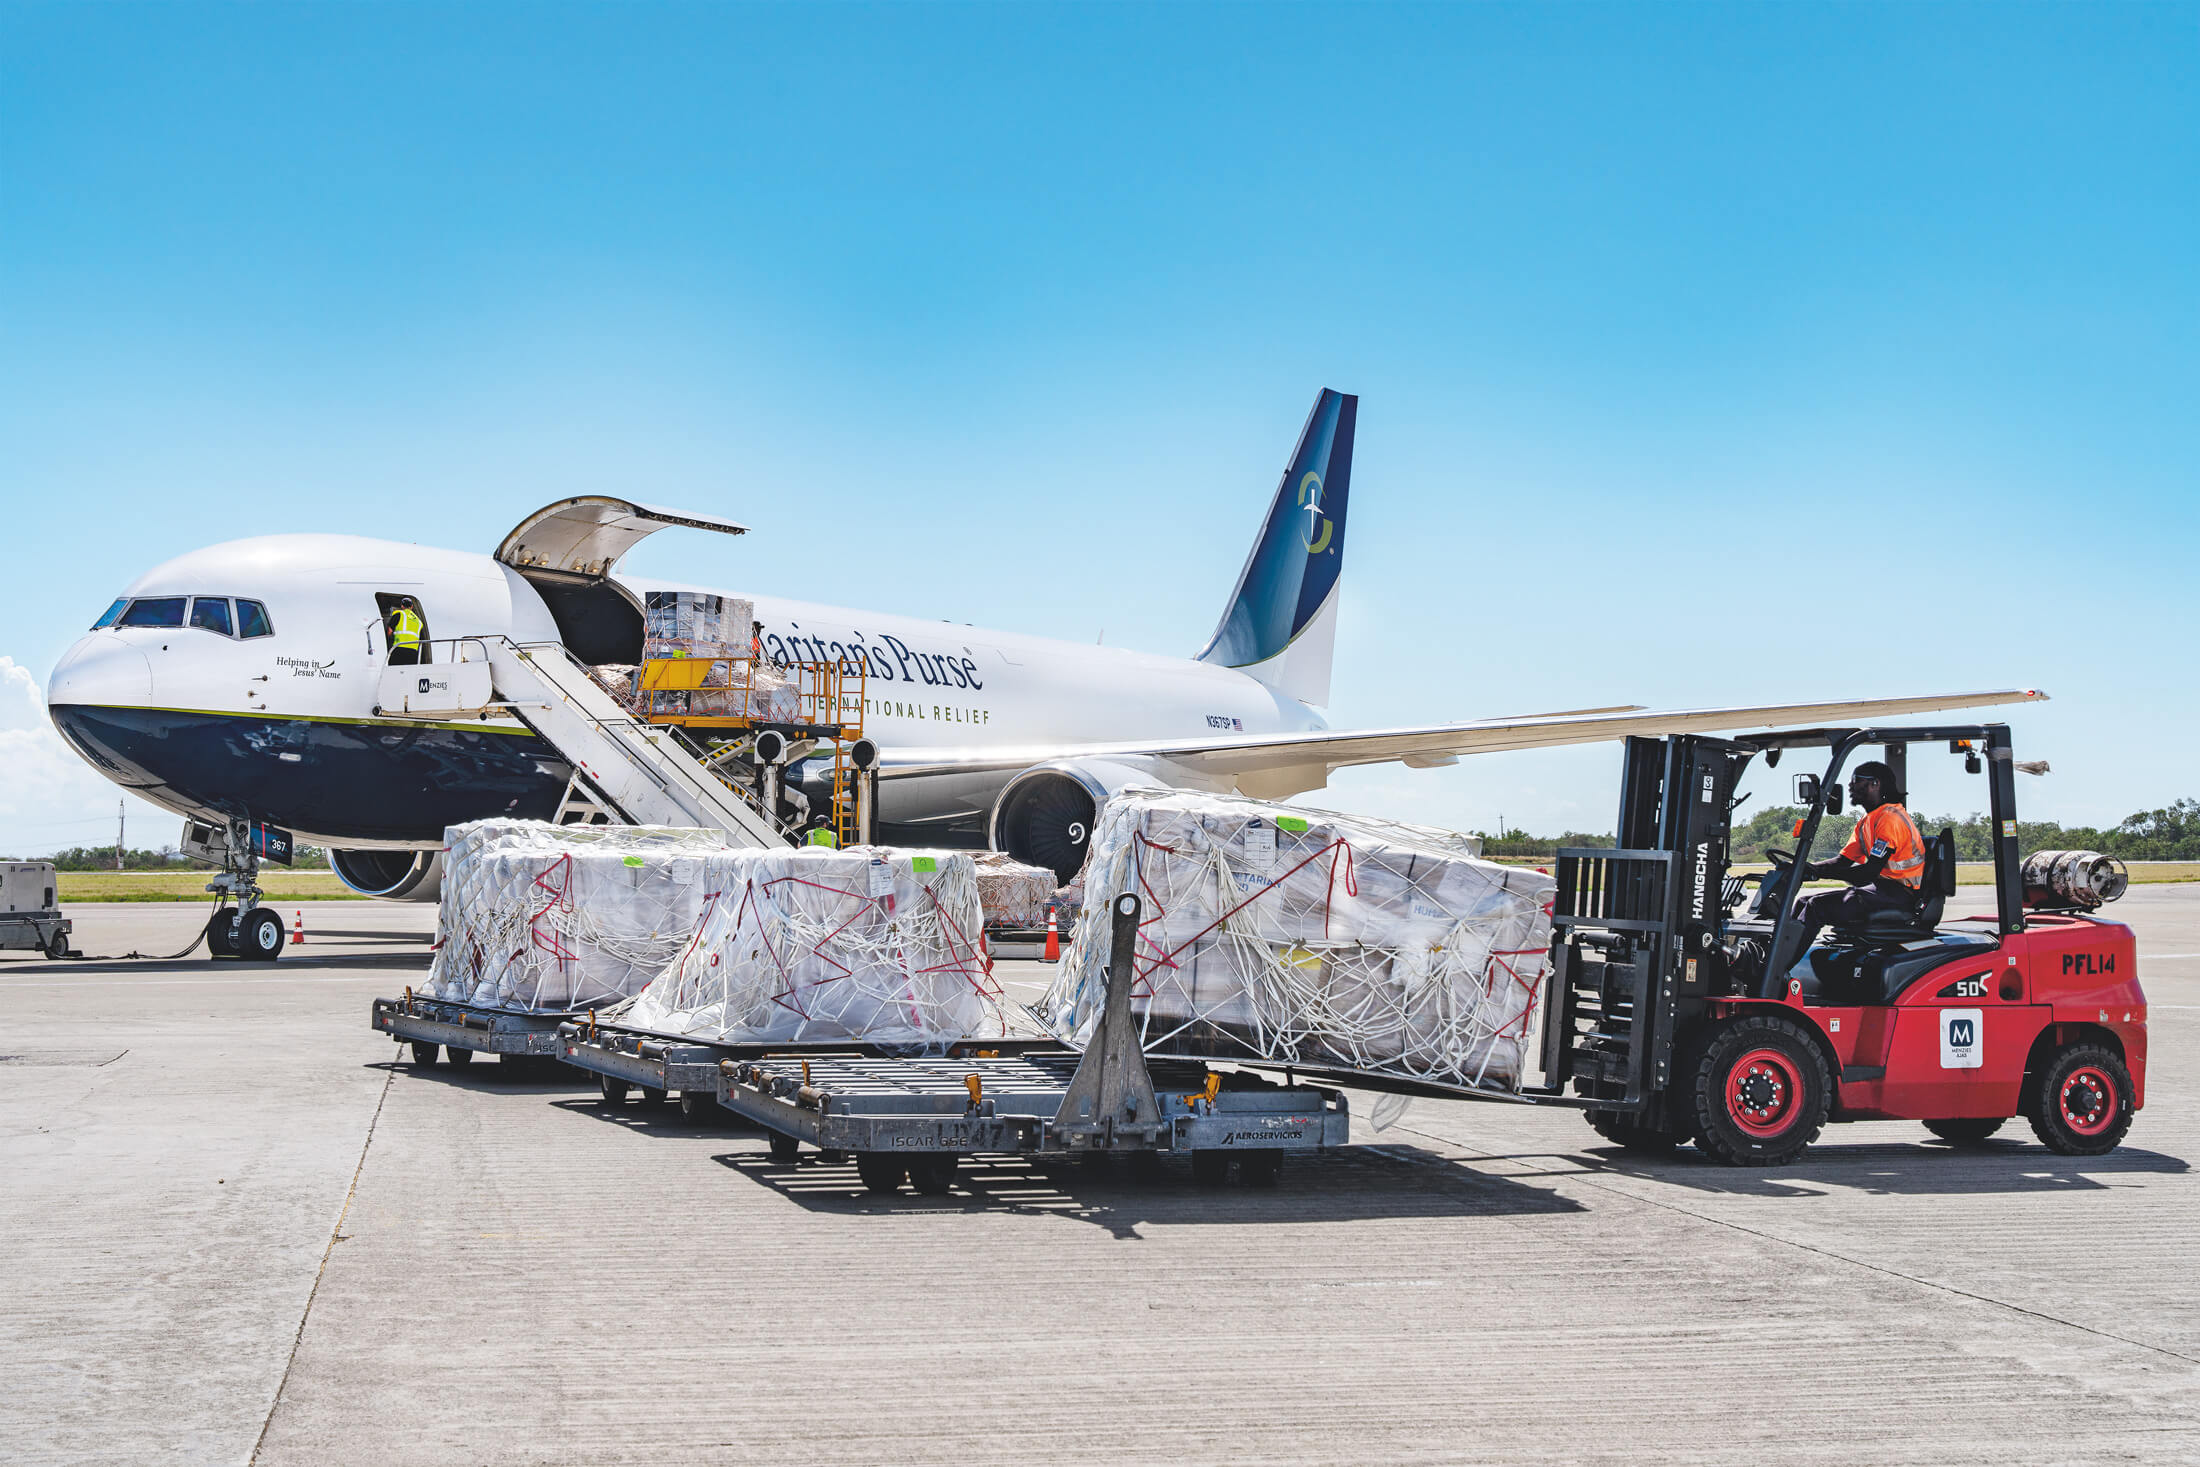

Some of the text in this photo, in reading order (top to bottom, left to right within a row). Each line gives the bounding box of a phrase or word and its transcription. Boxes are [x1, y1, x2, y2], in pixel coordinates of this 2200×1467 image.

[276, 656, 321, 669] Helping in
[765, 622, 983, 690] aritan's Purse
[292, 667, 341, 679] Jesus' Name
[807, 695, 989, 725] TERNATIONAL RELIEF
[1206, 715, 1230, 729] N367SP
[272, 839, 286, 852] 367
[1692, 842, 1709, 919] HANGCHA
[2062, 953, 2115, 975] PFL14
[1952, 1024, 1971, 1043] M
[891, 1136, 935, 1147] ISCAR
